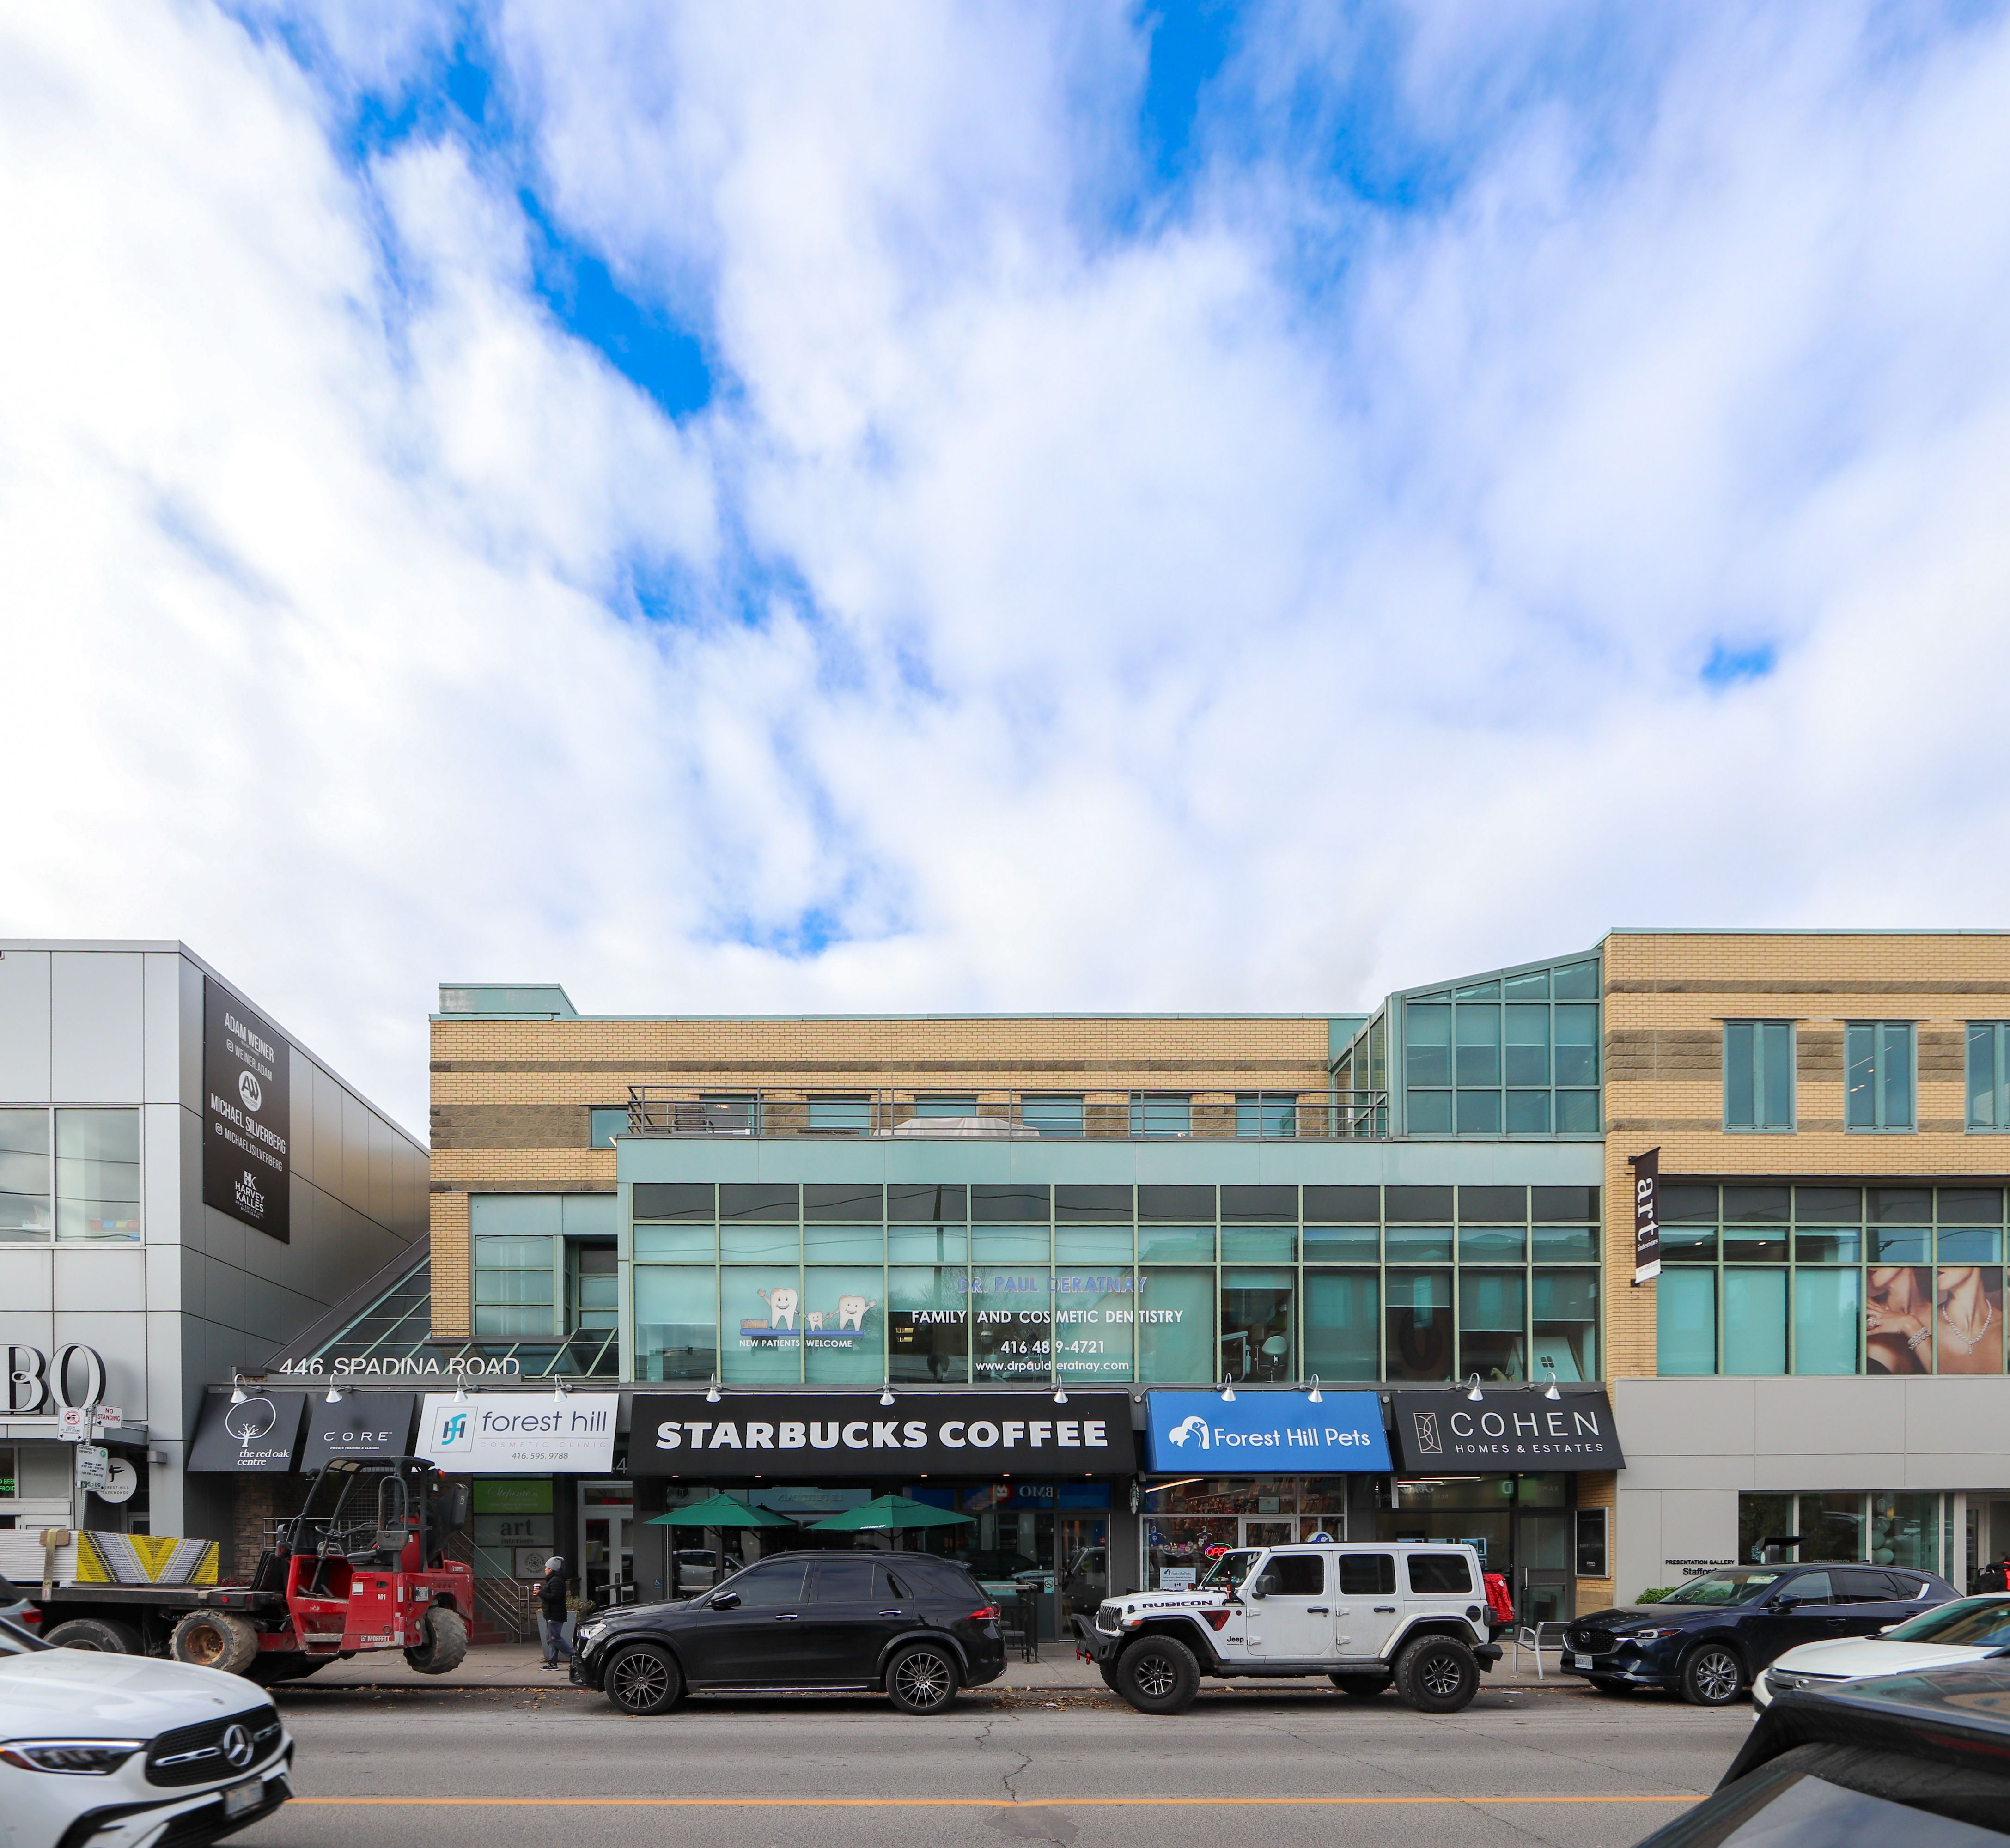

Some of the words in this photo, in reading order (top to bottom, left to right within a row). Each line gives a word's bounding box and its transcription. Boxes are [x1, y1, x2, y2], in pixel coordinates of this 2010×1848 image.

[225, 1013, 246, 1042] ADAM
[248, 1029, 274, 1063] WEINER
[235, 1045, 272, 1081] WEINER.ADAM
[211, 1093, 244, 1128] MICHAEL
[245, 1116, 286, 1154] SILVERBERG
[225, 1128, 282, 1172] MICHAELJSILVERBERG
[235, 1181, 264, 1203] HARVEY
[236, 1191, 264, 1213] KALLES
[1638, 1177, 1659, 1241] art
[1638, 1238, 1659, 1252] interiors
[958, 1277, 988, 1293] DR.
[995, 1277, 1039, 1293] PAUL
[1047, 1277, 1147, 1293] DERATNAY
[912, 1311, 967, 1324] FAMILY
[977, 1310, 1011, 1324] AND
[1001, 1341, 1027, 1354] 416
[1032, 1341, 1104, 1354] 489-4721
[279, 1358, 323, 1375] 446
[333, 1357, 437, 1375] SPADINA
[449, 1357, 520, 1375] ROAD
[975, 1360, 1129, 1373] www.drpaulderatnay.com
[482, 1411, 562, 1432] forest
[571, 1411, 606, 1432] hill
[1450, 1411, 1600, 1437] COHEN
[656, 1421, 928, 1449] STARBUCKS
[939, 1421, 1108, 1448] COFFEE
[1214, 1428, 1280, 1447] Forest
[1286, 1428, 1319, 1447] Hill
[1326, 1428, 1371, 1447] Pets
[239, 1449, 254, 1458] the
[256, 1449, 271, 1458] red
[273, 1449, 289, 1458] oak
[1456, 1444, 1509, 1453] HOMES
[1517, 1444, 1526, 1453] &
[1533, 1443, 1604, 1453] ESTATES
[500, 1519, 534, 1536] art
